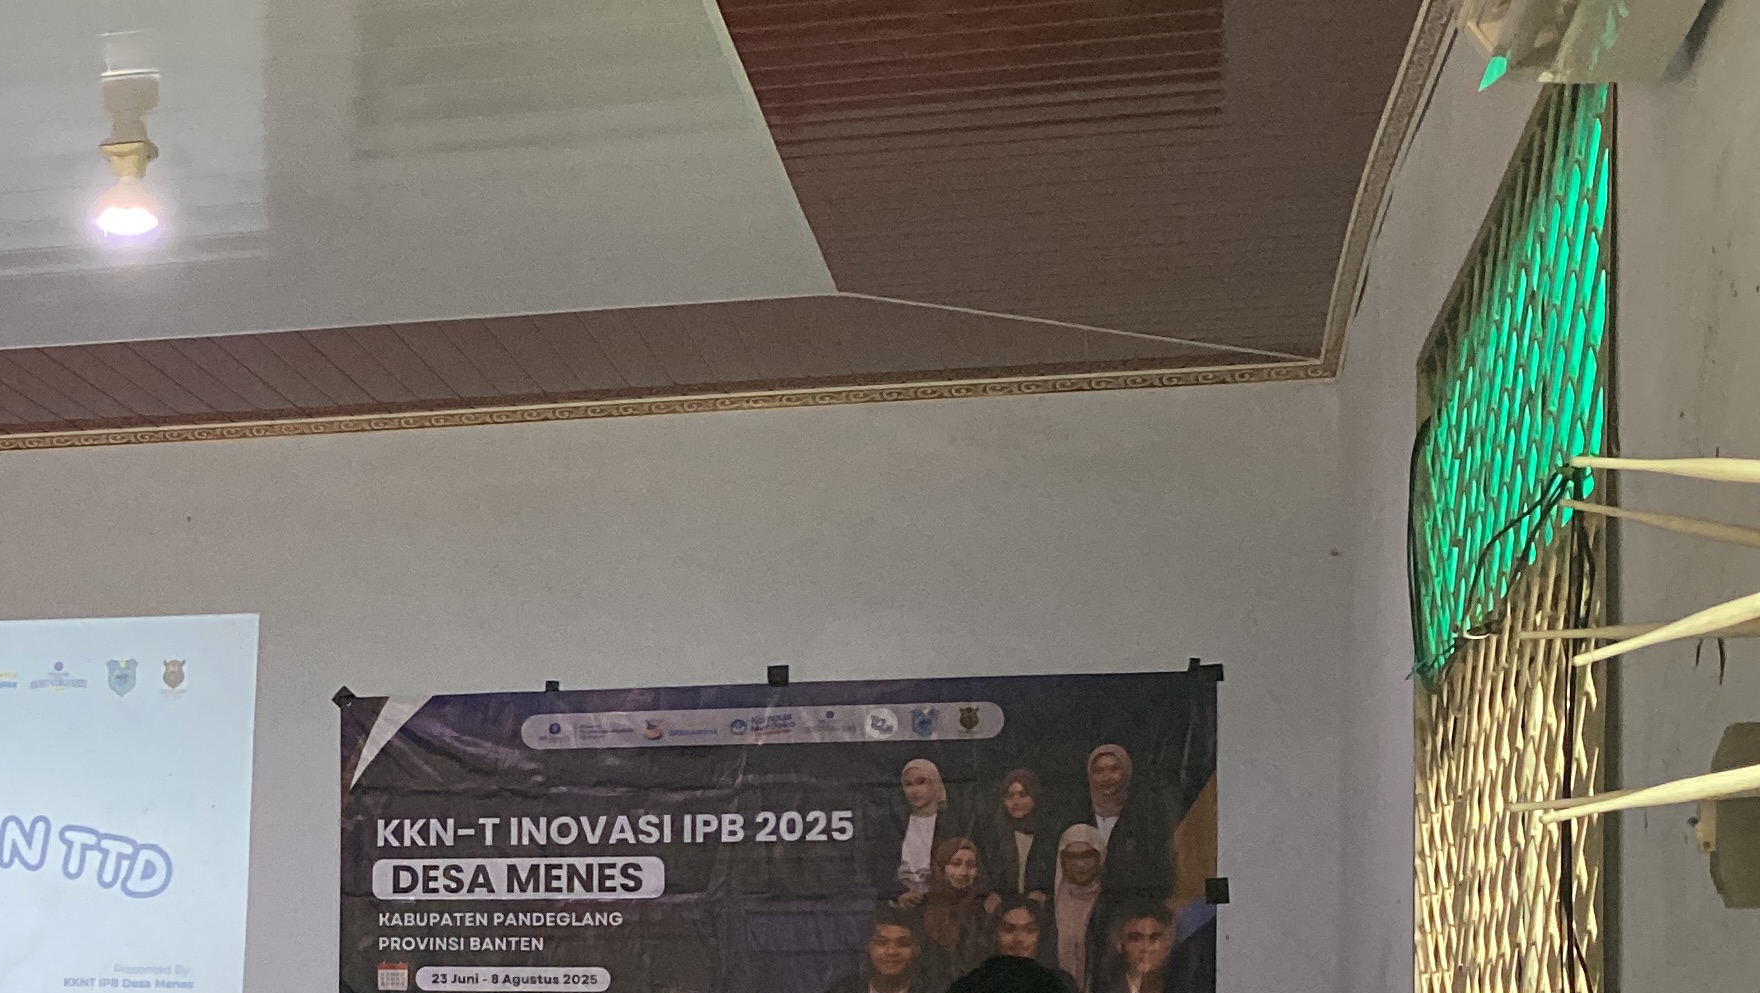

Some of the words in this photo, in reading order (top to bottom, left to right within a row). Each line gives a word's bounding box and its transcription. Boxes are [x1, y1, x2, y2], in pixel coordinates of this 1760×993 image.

[377, 817, 500, 847] KKN-T
[510, 814, 671, 846] INOVASI
[683, 813, 745, 843] IPB
[754, 810, 854, 842] 2025
[60, 824, 173, 899] TTD
[392, 863, 495, 894] DESA
[506, 861, 643, 894] MENES
[378, 911, 488, 927] KABUPATEN
[493, 911, 623, 927] PANDEGLANG
[378, 936, 465, 951] PROVINSI
[470, 936, 544, 951] BANTEN
[122, 978, 151, 988] Desa
[155, 979, 193, 989] Menes
[431, 973, 448, 984] 23
[450, 973, 479, 984] Juni
[491, 974, 499, 984] 8
[502, 973, 559, 987] Agustus
[563, 974, 598, 985] 2025
